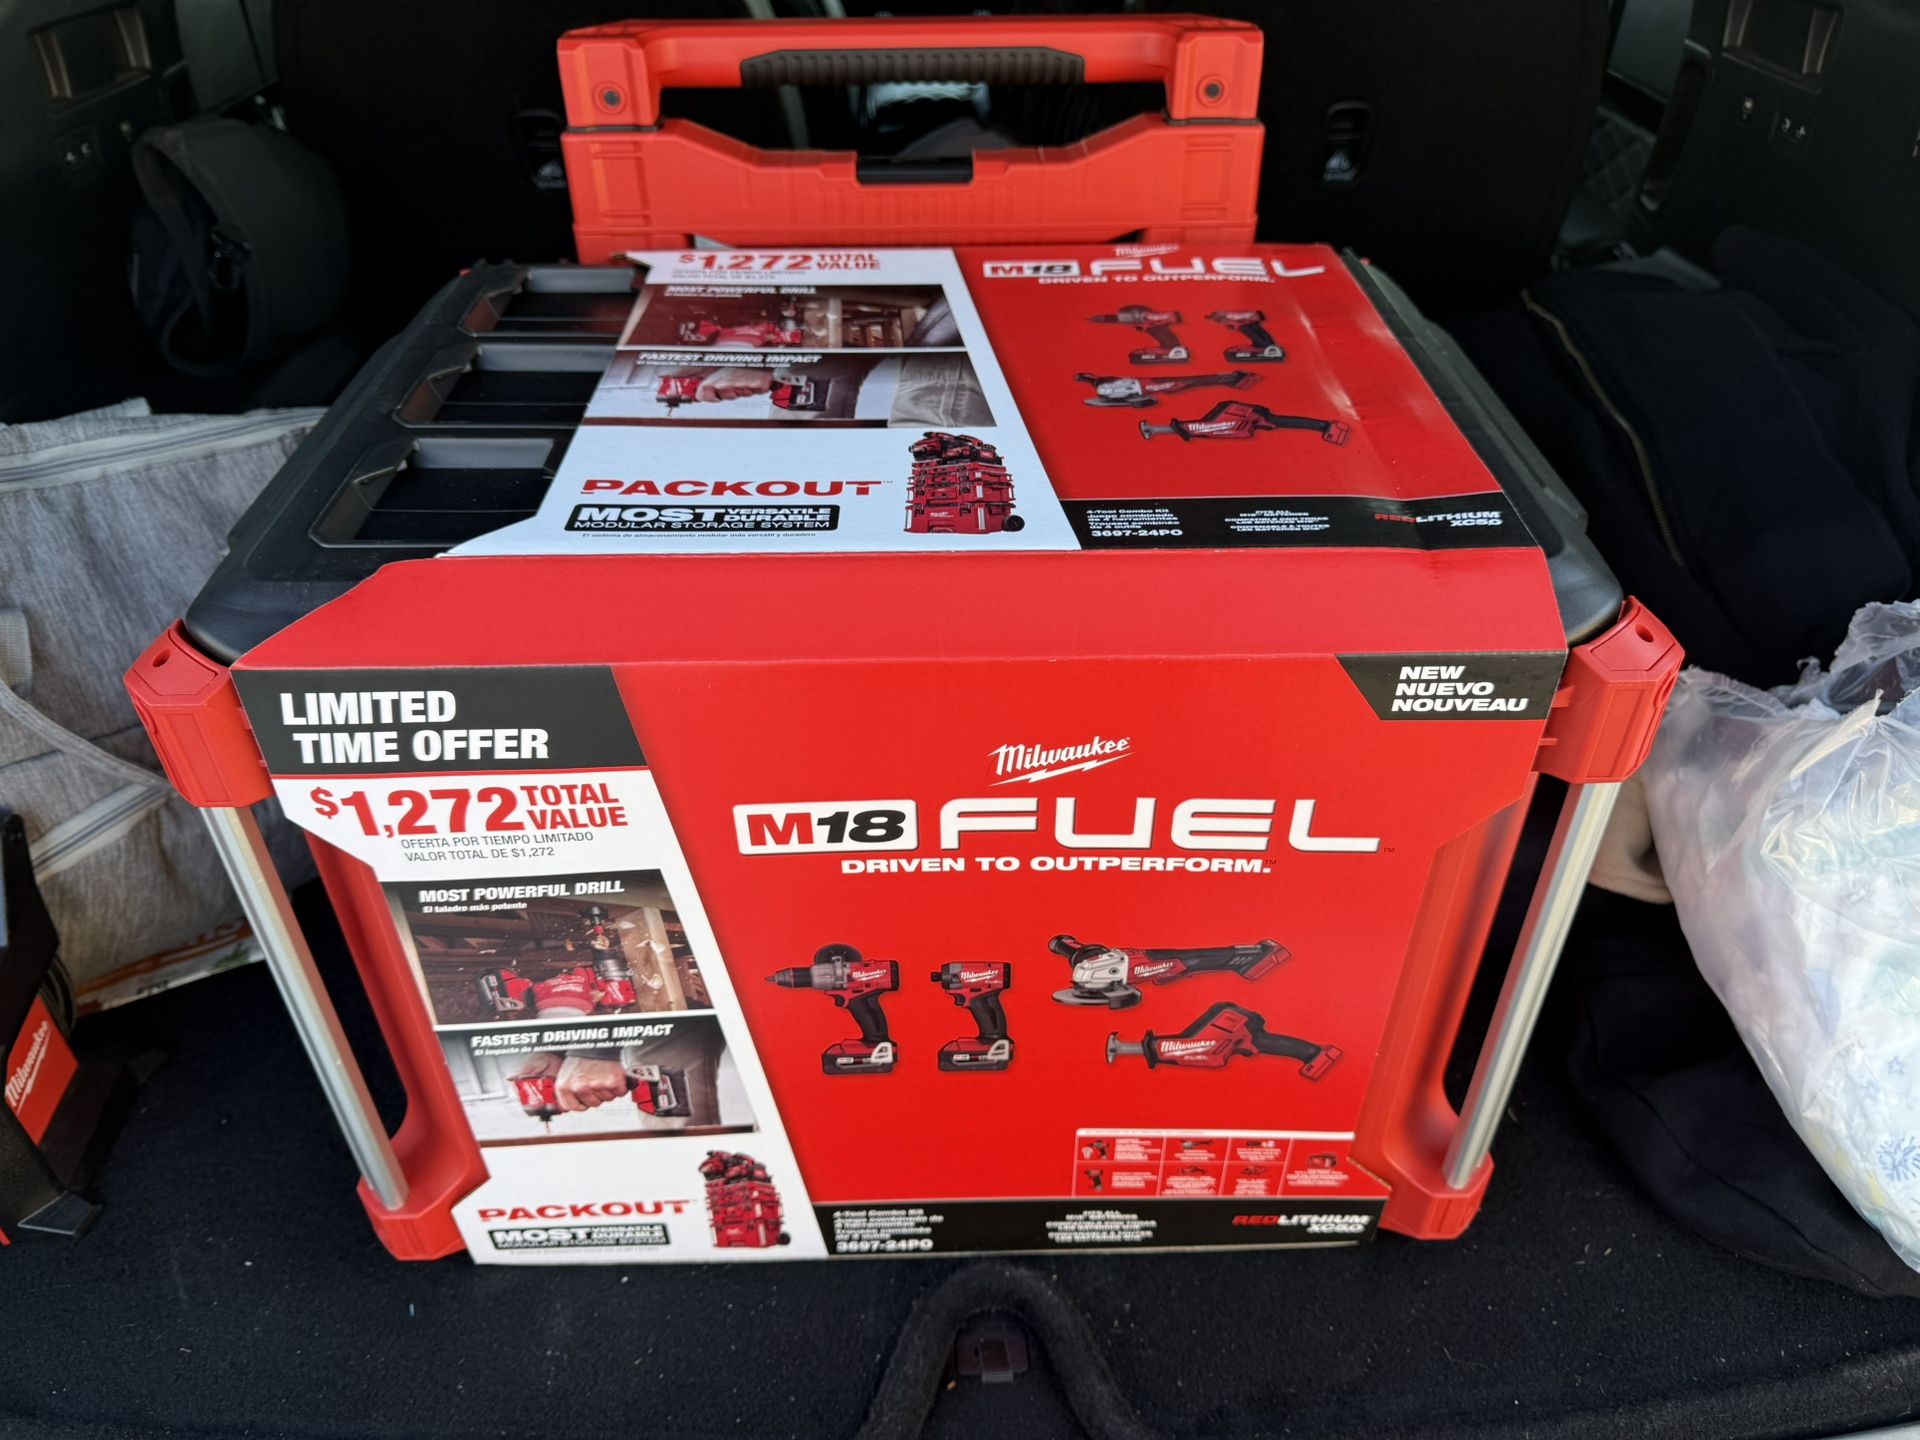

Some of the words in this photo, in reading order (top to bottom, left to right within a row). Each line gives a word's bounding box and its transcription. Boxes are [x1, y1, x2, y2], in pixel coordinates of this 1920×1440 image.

[678, 254, 813, 271] $1,272
[818, 253, 877, 262] TOTAL
[816, 262, 881, 270] VALUE
[988, 263, 1075, 276] M18
[1090, 257, 1325, 277] FUEL
[1038, 276, 1108, 284] DRIVEN
[1110, 275, 1138, 283] TO
[1143, 274, 1275, 283] OUTPERFORM.
[666, 285, 706, 294] MOST
[706, 286, 777, 294] POWERFUL
[639, 352, 702, 361] FASTEST
[704, 353, 763, 363] DRIVING
[766, 354, 822, 363] IMPACT
[580, 479, 882, 497] PACKOUT
[578, 507, 726, 521] MOST
[726, 507, 832, 515] VERSATILE
[724, 514, 832, 522] DURABLE
[1374, 511, 1501, 523] REDLITHIUM
[573, 521, 666, 529] MODULAR
[670, 521, 756, 529] STORAGE
[760, 521, 830, 529] SYSTEM
[1399, 665, 1466, 680] NEW
[1395, 682, 1494, 696] NUEVO
[279, 690, 456, 725] LIMITED
[1391, 697, 1528, 712] NOUVEAU
[293, 731, 399, 764] TIME
[412, 728, 549, 762] OFFER
[988, 735, 1131, 776] Milwaukee
[310, 786, 526, 838] $1,272
[520, 782, 619, 806] TOTAL
[527, 806, 628, 830] VALUE
[746, 809, 906, 847] M18
[940, 796, 1381, 852] FUEL
[401, 836, 450, 849] OFERTA
[453, 835, 480, 847] POR
[481, 833, 530, 846] TIEMPO
[534, 831, 594, 844] LIMITADO
[404, 850, 447, 862] VALOR
[448, 849, 488, 860] TOTAL
[491, 848, 509, 858] DE
[511, 846, 555, 859] $1,272
[841, 857, 966, 874] DRIVEN
[975, 857, 1020, 872] TO
[1030, 856, 1272, 873] OUTPERFORM.
[418, 889, 470, 902] MOST
[474, 884, 570, 900] POWERFUL
[574, 881, 625, 895] DRILL
[469, 903, 490, 911] más
[491, 902, 528, 912] potente
[471, 1031, 539, 1048] FASTEST
[542, 1027, 608, 1043] DRIVING
[612, 1024, 674, 1039] IMPACT
[478, 1200, 691, 1221] PACKOUT
[1232, 1214, 1371, 1226] REDLITHIUM
[493, 1228, 591, 1244] MOST
[836, 1238, 933, 1252] 3697-24PO
